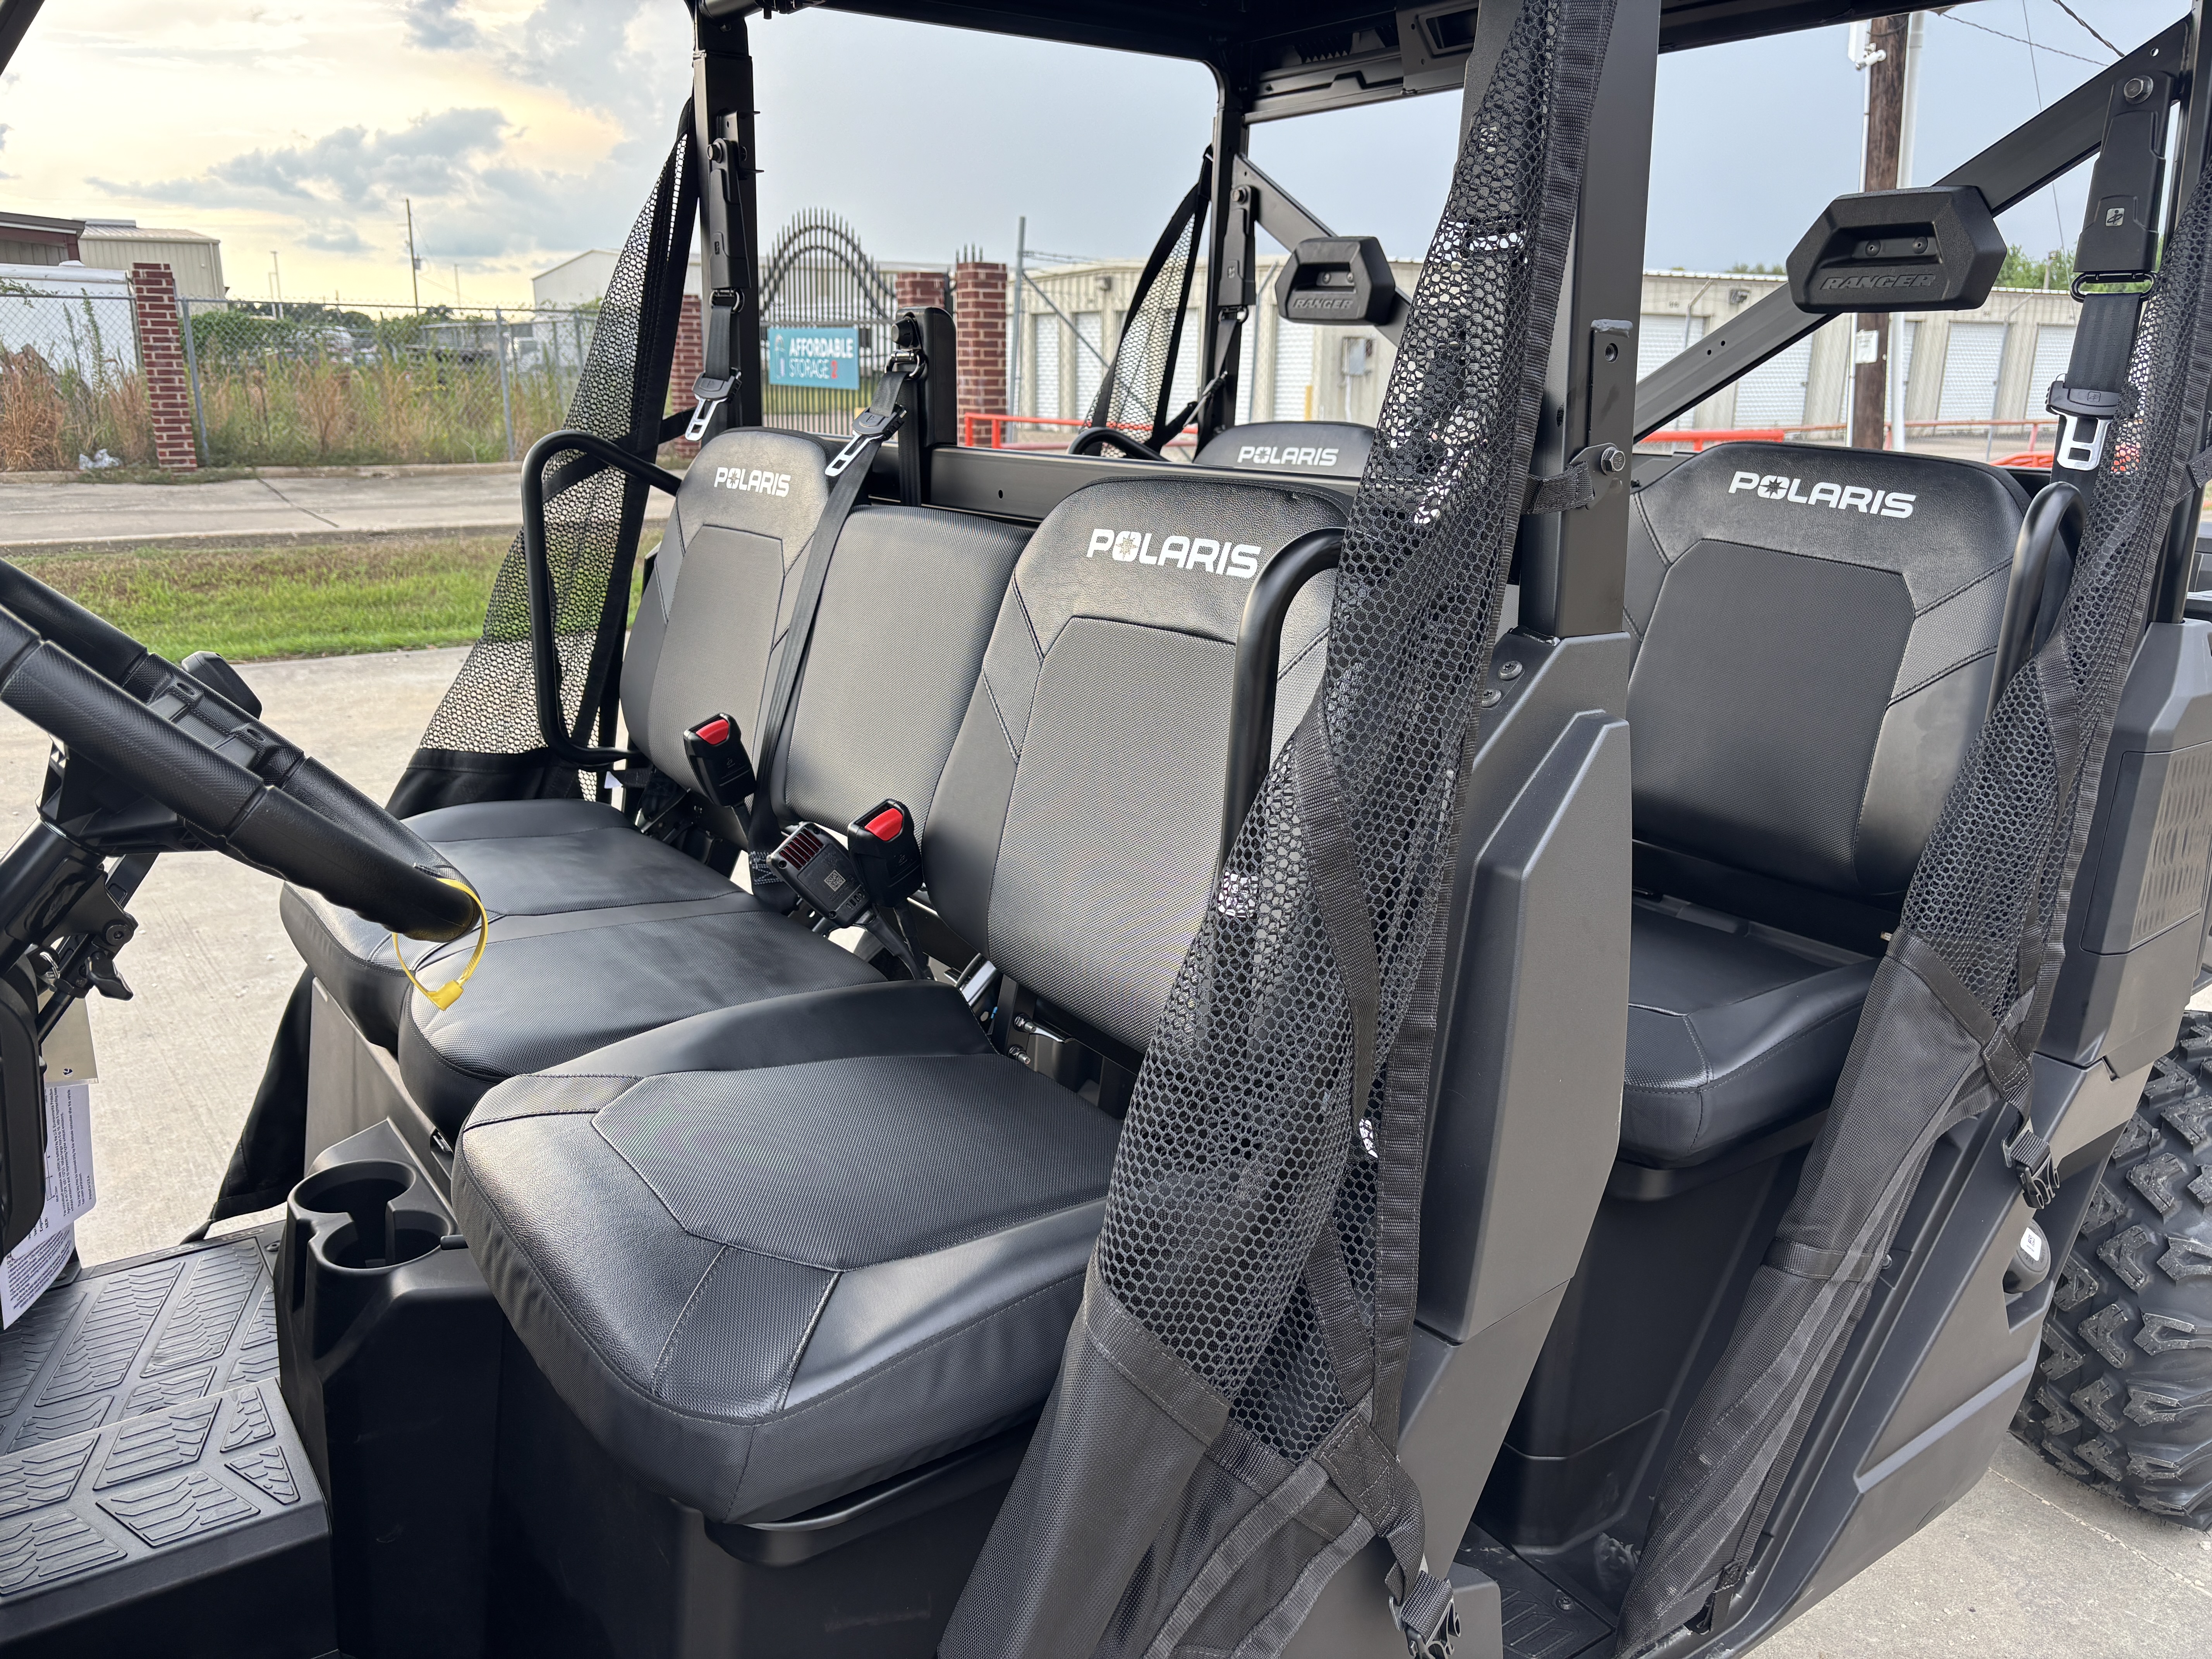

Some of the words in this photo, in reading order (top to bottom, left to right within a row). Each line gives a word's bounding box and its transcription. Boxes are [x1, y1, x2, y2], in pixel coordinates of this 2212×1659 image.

[1820, 273, 1936, 290] RANGER
[1293, 299, 1353, 309] RANGER
[789, 338, 854, 358] AFFORDABLE
[788, 359, 830, 379] STORAGE
[830, 360, 838, 379] 2
[1237, 446, 1339, 466] POLARIS
[714, 467, 791, 497] POLARIS
[1728, 471, 1917, 519] POLARIS
[1086, 528, 1262, 579] POLARIS
